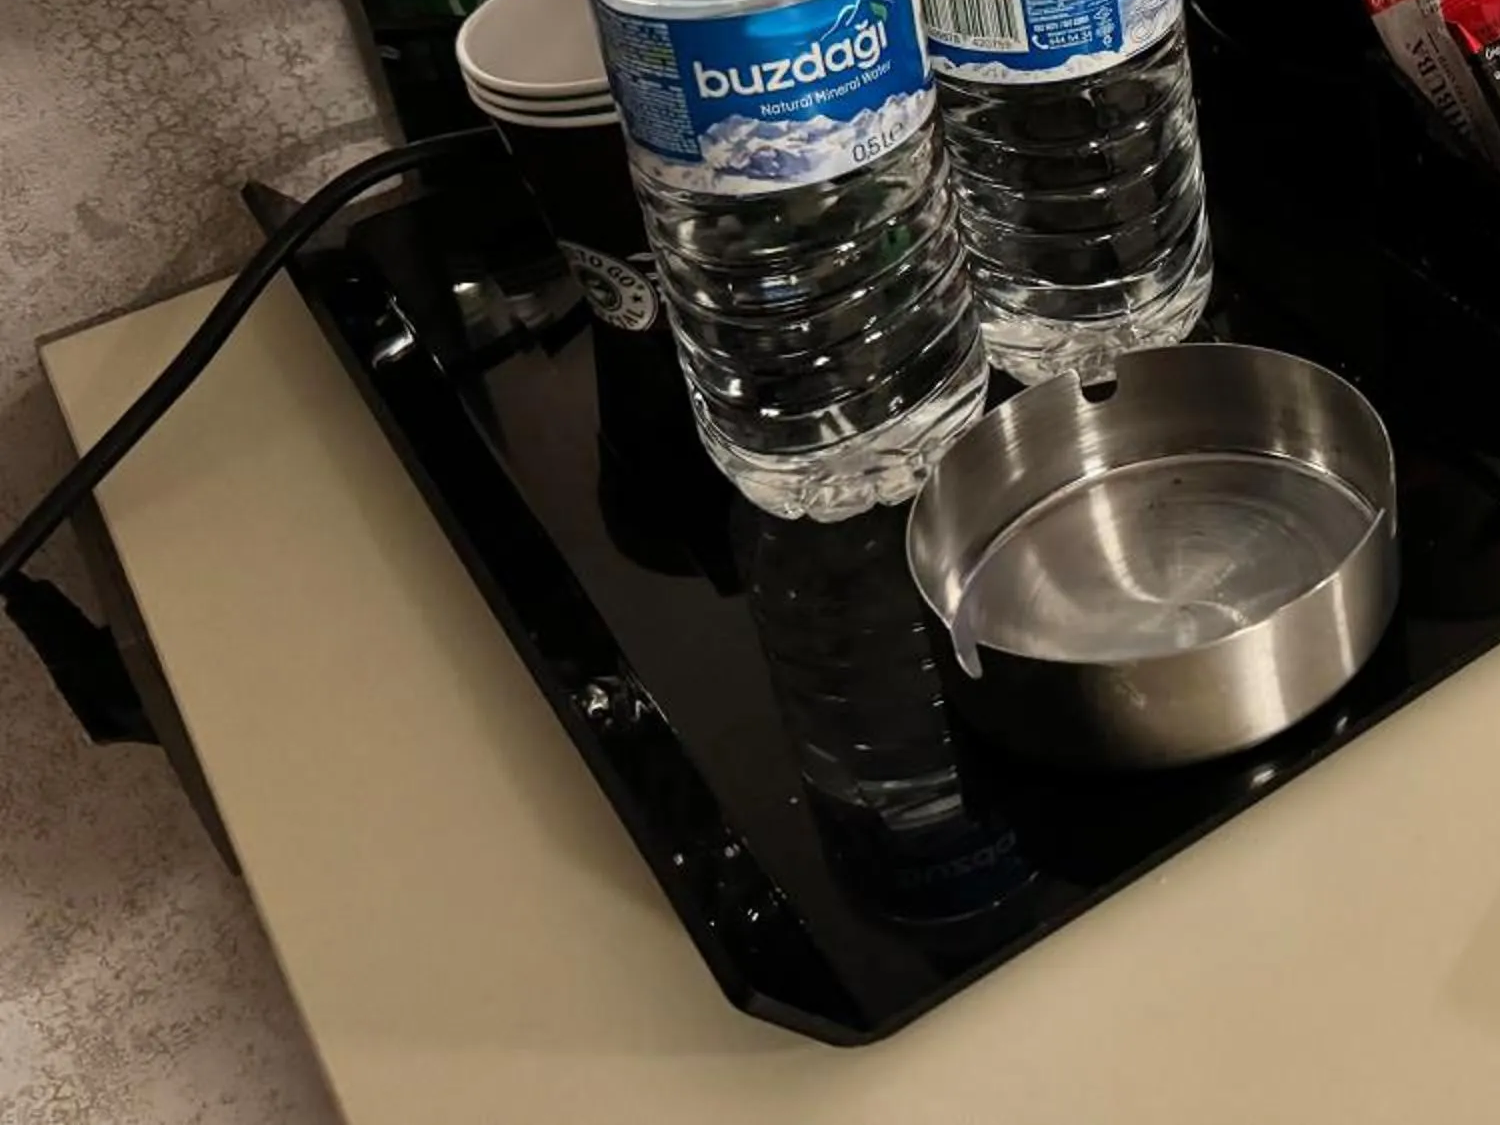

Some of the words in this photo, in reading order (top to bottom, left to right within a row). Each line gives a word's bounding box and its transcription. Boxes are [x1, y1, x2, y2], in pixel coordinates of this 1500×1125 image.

[693, 19, 887, 98] buzdağı
[760, 96, 812, 117] Natural
[814, 76, 861, 104] Mineral
[862, 59, 892, 85] Water
